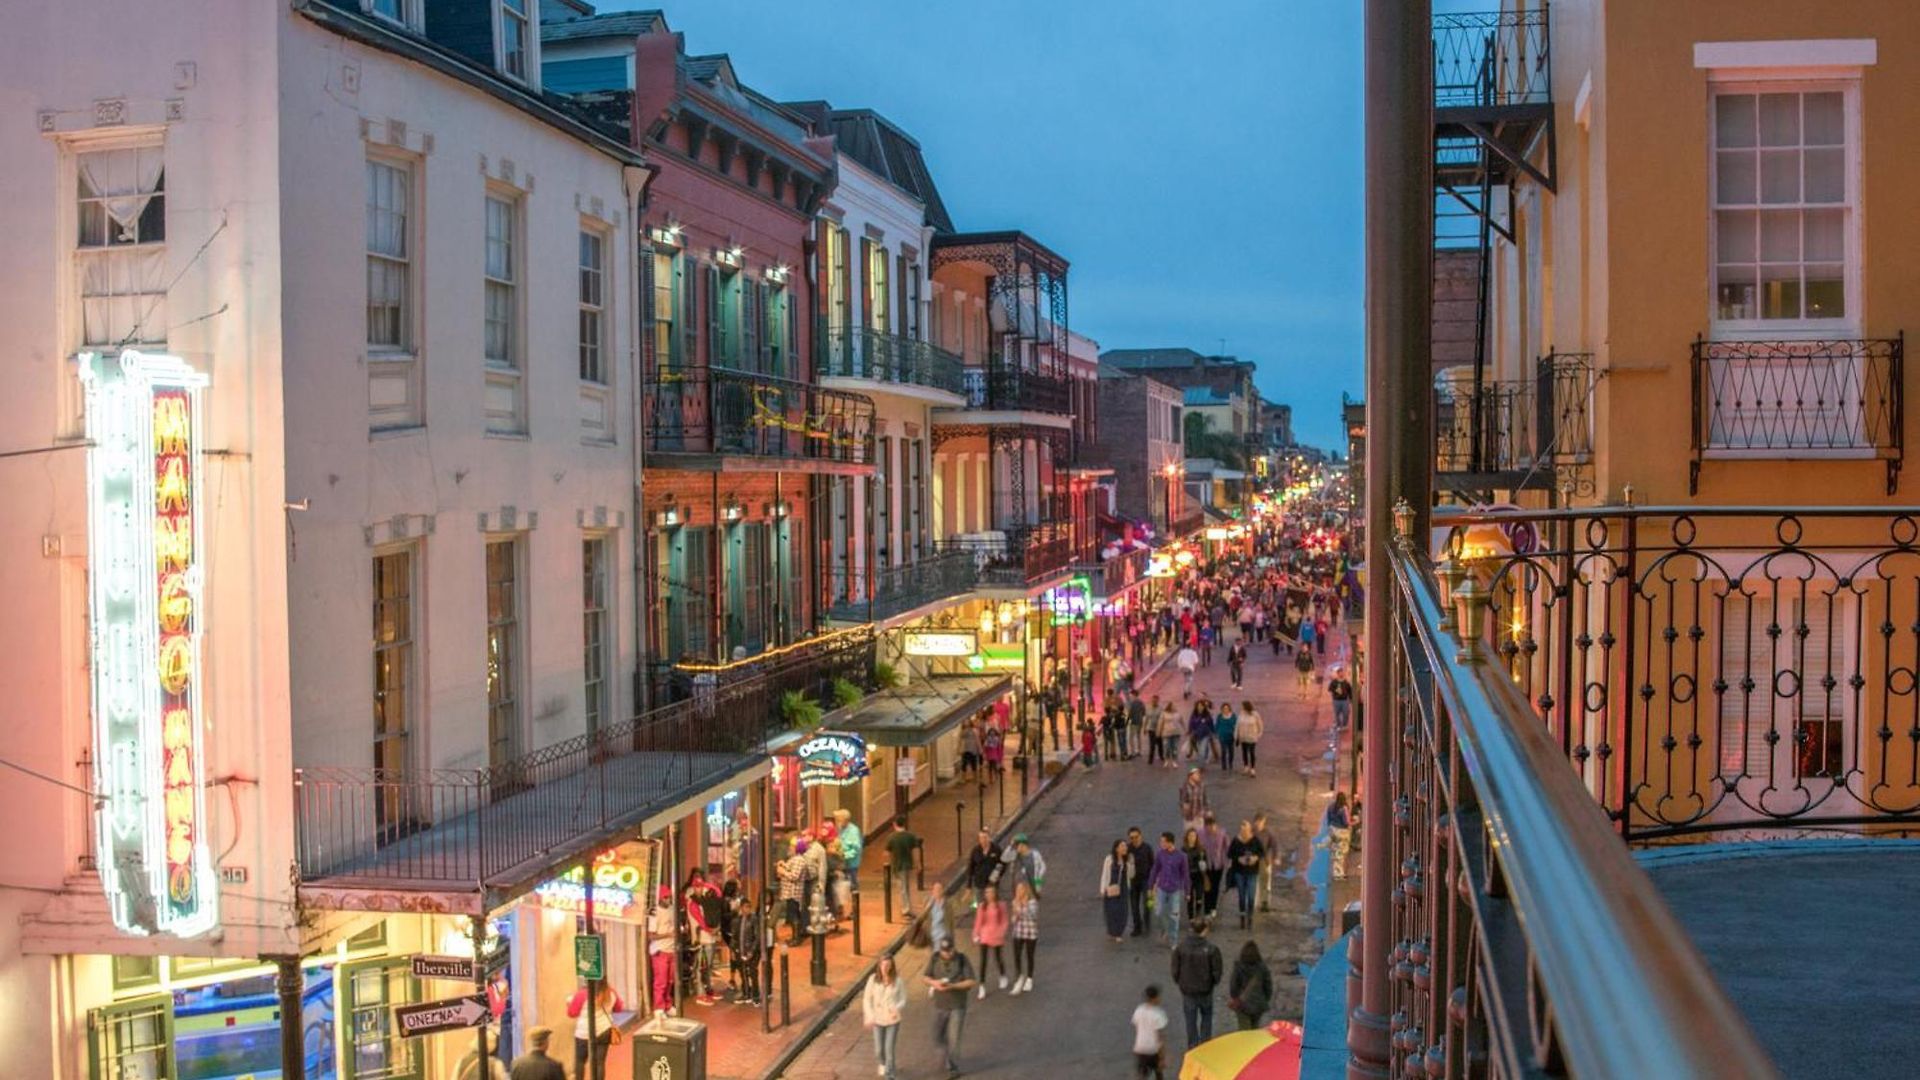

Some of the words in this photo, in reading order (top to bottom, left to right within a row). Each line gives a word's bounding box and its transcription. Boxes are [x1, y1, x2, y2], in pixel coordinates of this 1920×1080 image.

[154, 397, 191, 695] MANGO
[799, 738, 855, 760] OCEANA
[164, 708, 192, 902] MANGO
[415, 961, 471, 976] Iberville
